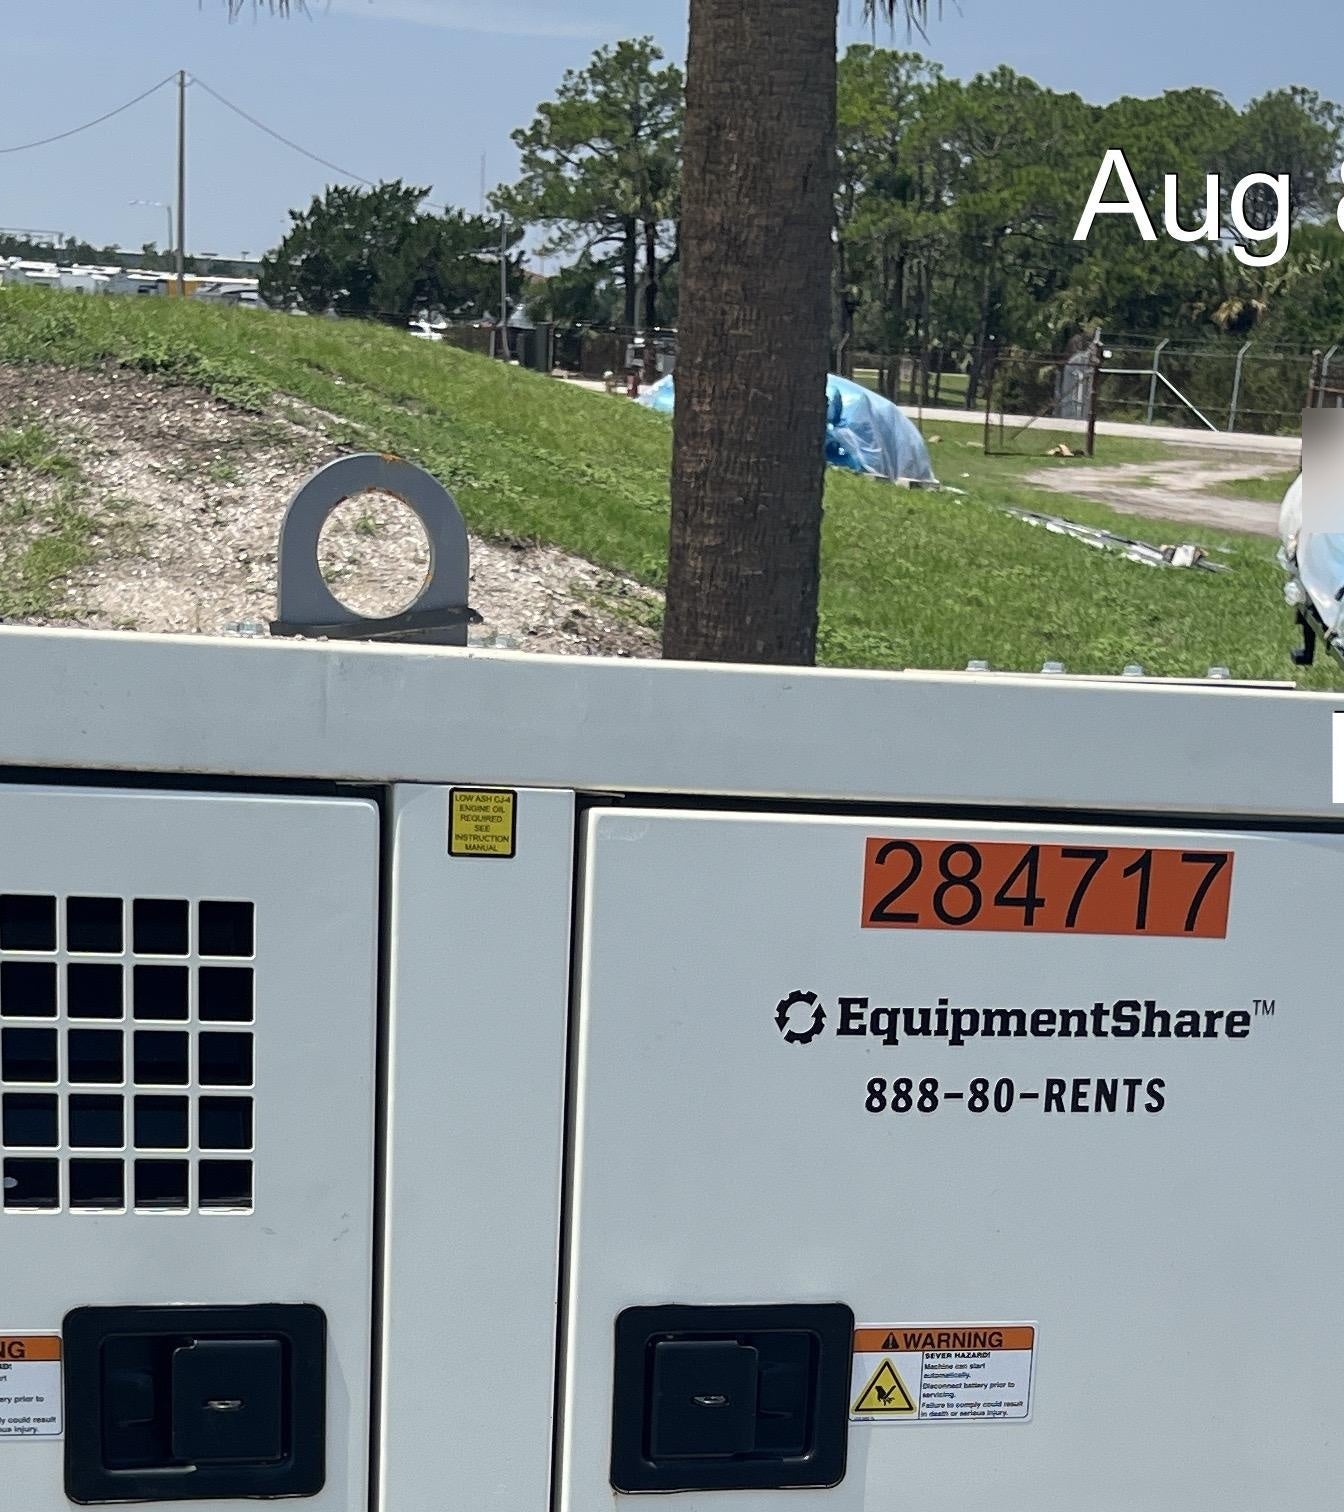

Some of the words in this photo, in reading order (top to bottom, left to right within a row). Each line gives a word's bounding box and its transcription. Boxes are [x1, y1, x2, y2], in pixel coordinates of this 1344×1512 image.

[455, 794, 473, 802] LOW
[476, 795, 492, 803] ASH
[459, 804, 490, 813] ENGINE
[492, 805, 505, 813] OIL
[474, 824, 490, 832] SEE
[454, 833, 510, 843] INSTRUCTION
[464, 843, 498, 852] MANUAL
[869, 841, 1228, 932] 284717
[865, 1077, 1167, 1114] 888-80-RENTS
[903, 1332, 1004, 1349] WARNING
[963, 1382, 988, 1390] battery
[989, 1381, 1006, 1390] prior
[955, 1401, 981, 1409] comply
